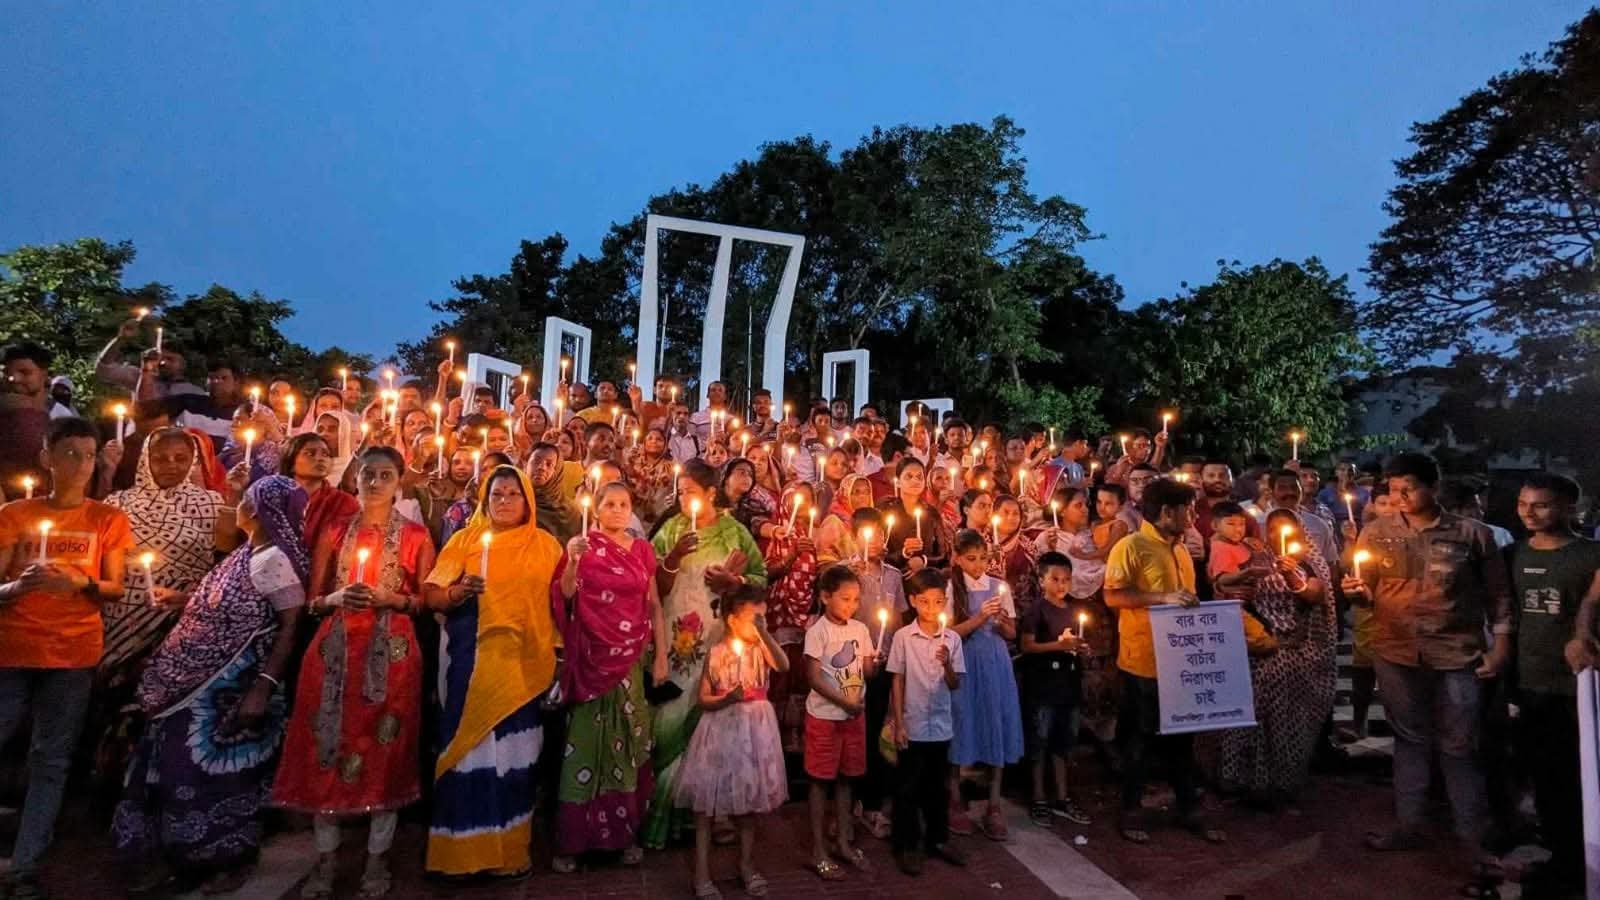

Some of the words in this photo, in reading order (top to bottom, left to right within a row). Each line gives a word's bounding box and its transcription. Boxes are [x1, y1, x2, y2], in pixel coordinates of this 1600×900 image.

[1175, 615, 1194, 628] বার
[1198, 613, 1217, 625] বার
[1168, 633, 1204, 648] উচ্ছেদ
[1208, 632, 1225, 643] নয়
[1194, 689, 1216, 704] চাই
